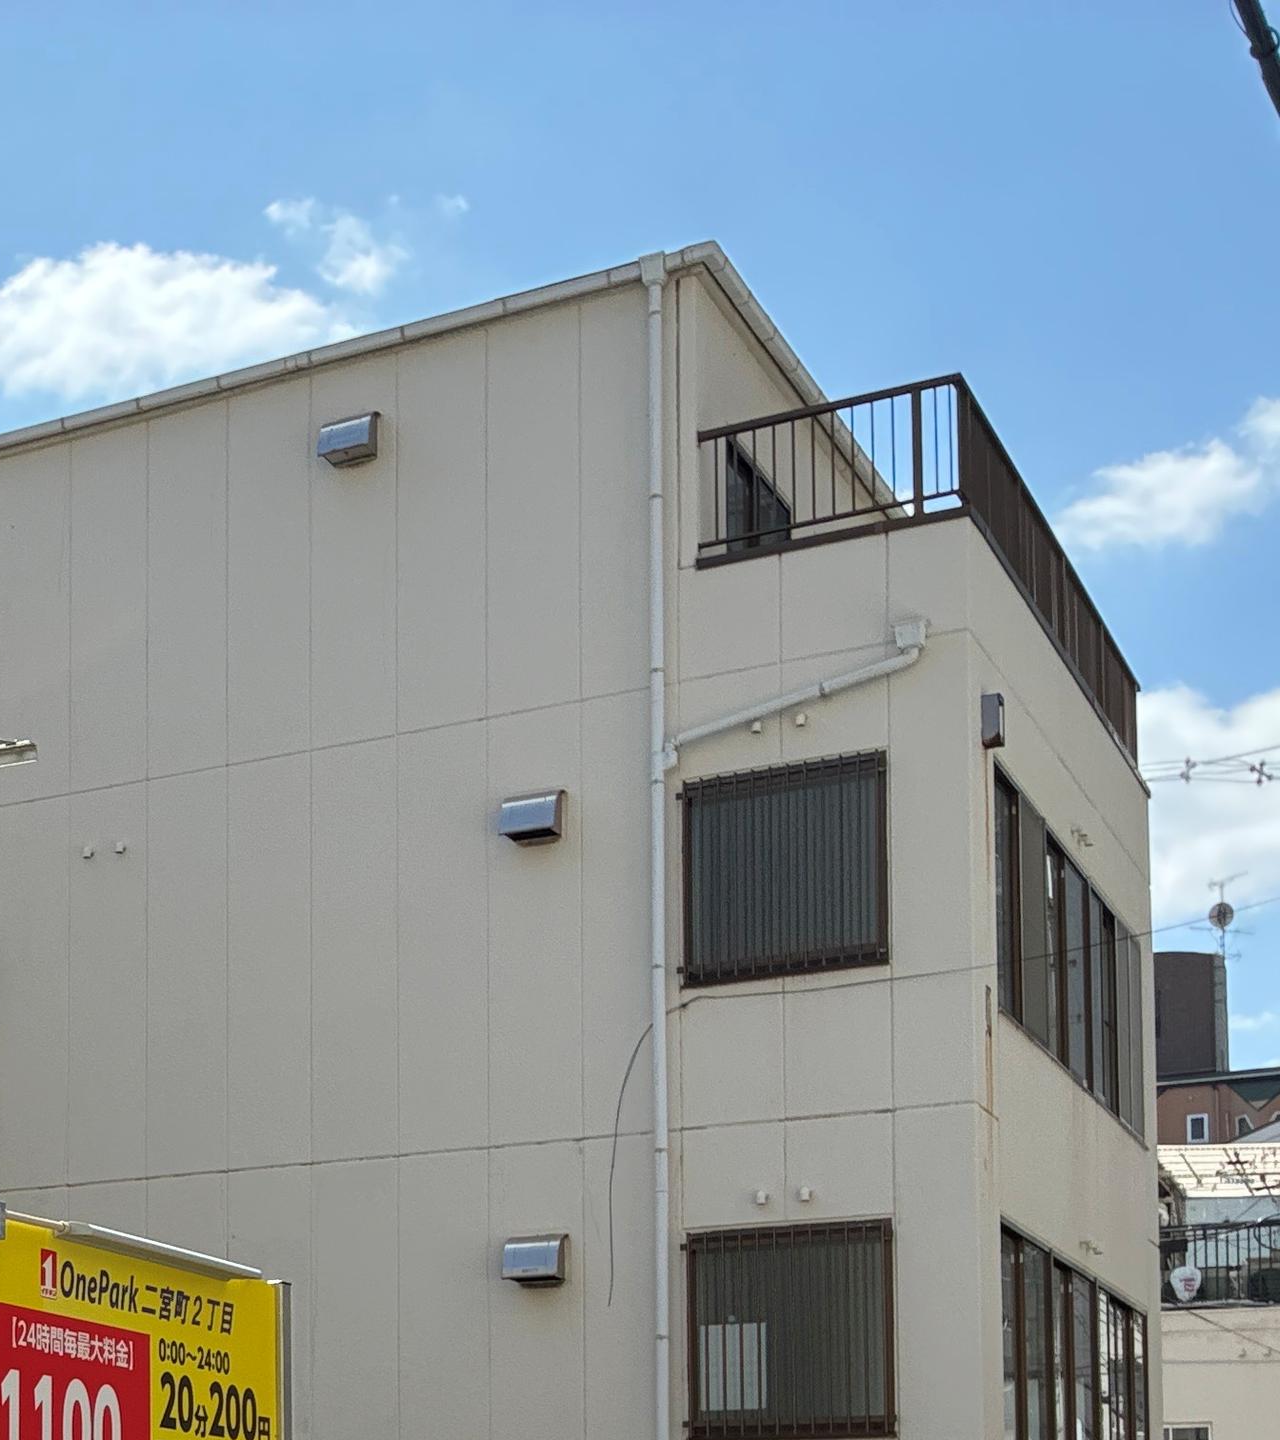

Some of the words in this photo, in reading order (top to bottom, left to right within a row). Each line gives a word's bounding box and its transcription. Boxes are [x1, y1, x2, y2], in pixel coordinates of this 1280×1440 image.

[60, 1261, 140, 1313] OnePark
[11, 1316, 134, 1371] 【24時間毎最大料金】
